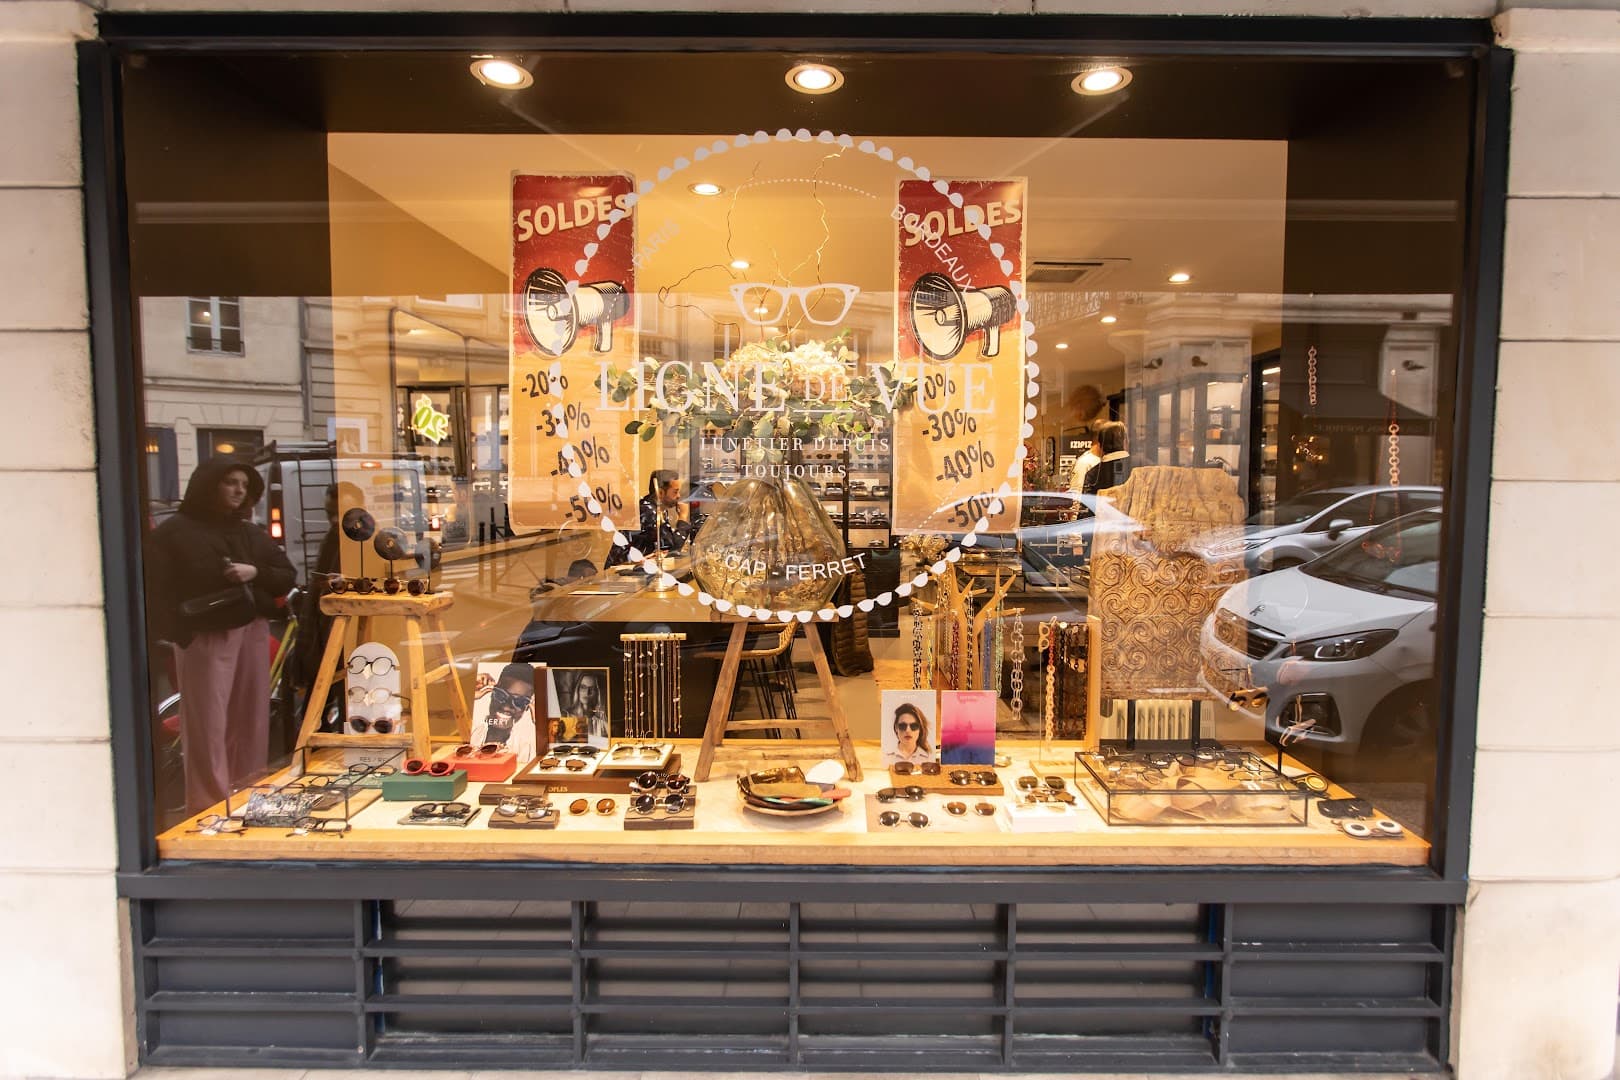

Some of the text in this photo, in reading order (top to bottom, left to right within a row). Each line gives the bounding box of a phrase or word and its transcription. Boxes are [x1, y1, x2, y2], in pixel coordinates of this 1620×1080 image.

[517, 194, 633, 242] SOLDES
[905, 200, 1022, 247] SOLDES
[632, 218, 680, 269] PARIS
[595, 360, 994, 415] LIGNE DE VUE
[700, 437, 890, 451] LUNETIER DEPUIS
[922, 408, 977, 442] -30%
[741, 464, 847, 481] TOUJOURS
[936, 440, 995, 483] -40%
[724, 553, 767, 576] CAP
[785, 552, 867, 581] FERRET
